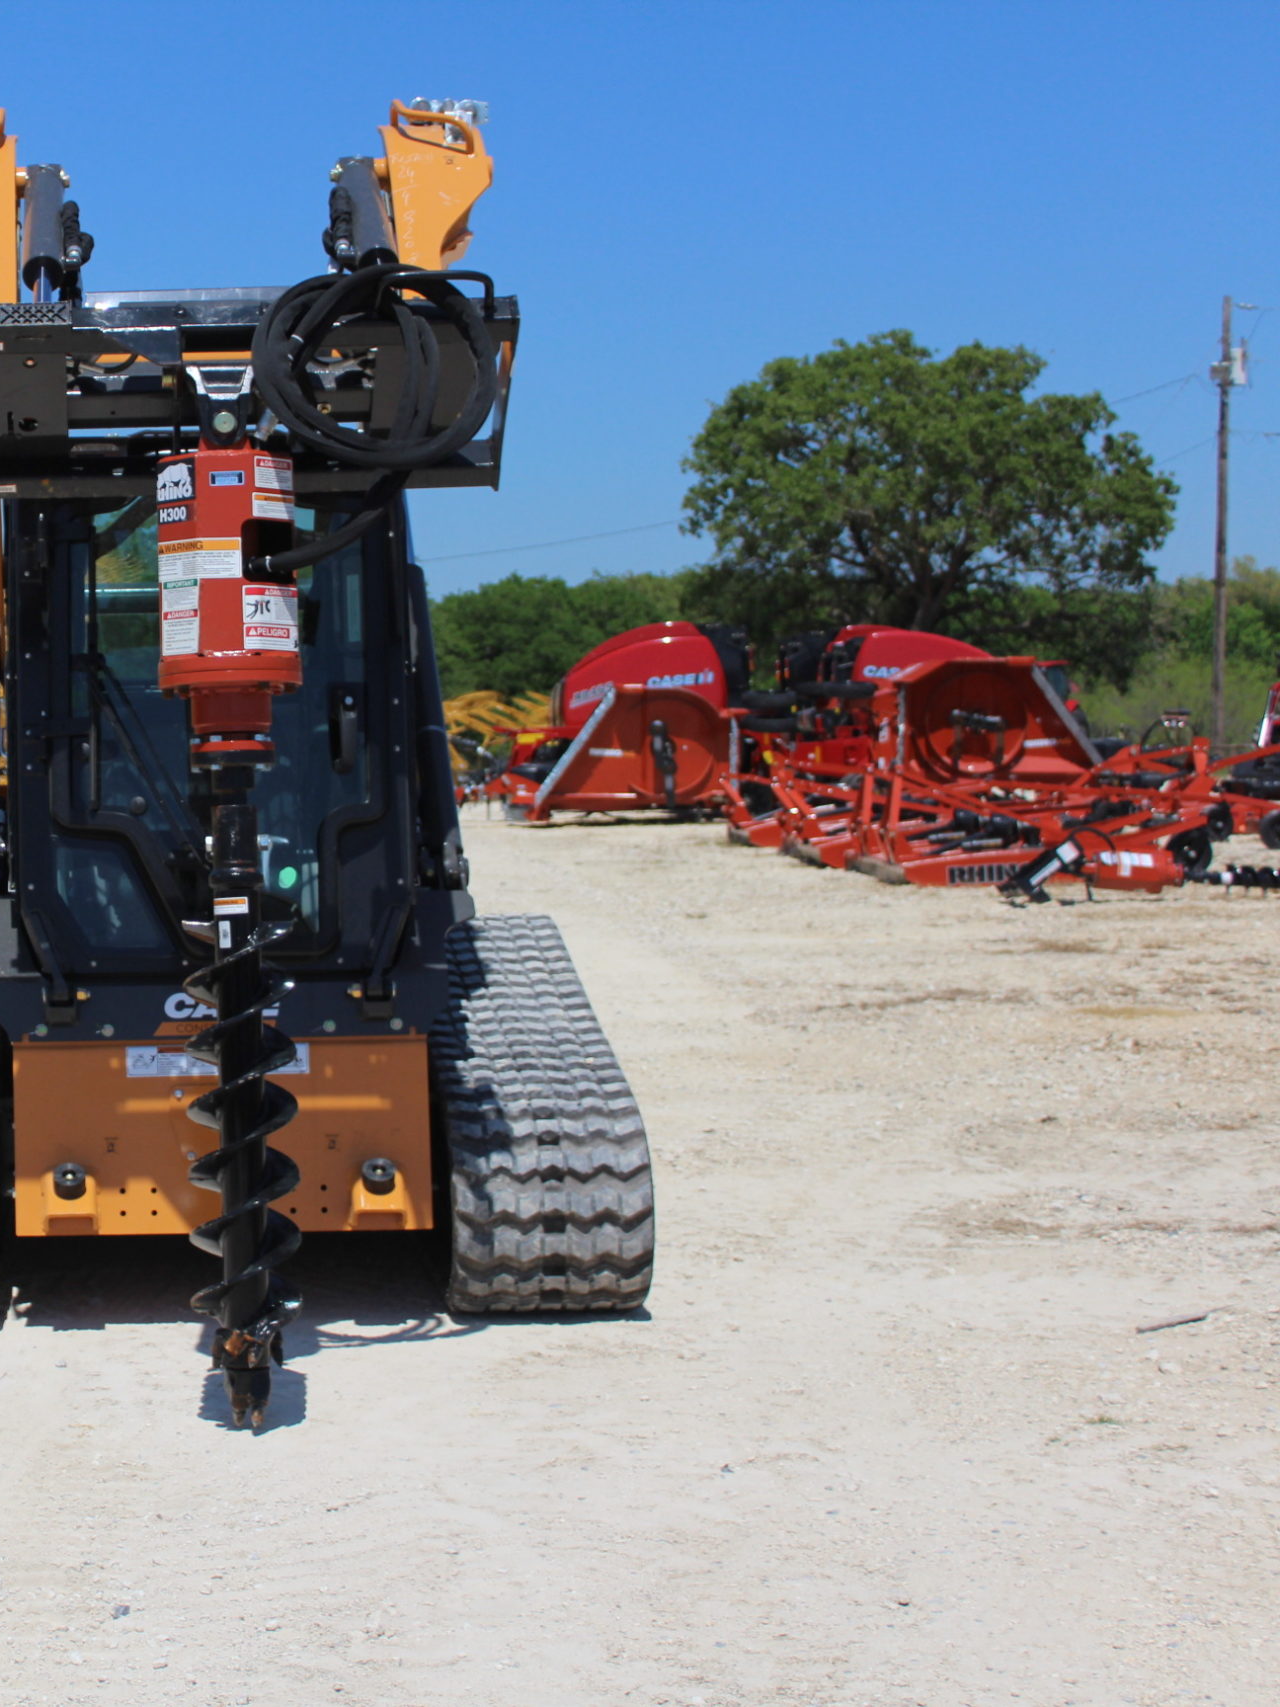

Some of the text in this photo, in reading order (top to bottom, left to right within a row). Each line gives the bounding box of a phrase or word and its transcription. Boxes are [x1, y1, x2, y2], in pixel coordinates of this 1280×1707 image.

[160, 506, 187, 523] H300
[165, 541, 204, 554] WARNING
[166, 580, 195, 588] IMPORTANT
[257, 627, 289, 638] PELIGRO
[863, 665, 902, 678] CAS
[646, 673, 697, 689] CASE
[948, 863, 1021, 886] RHIN
